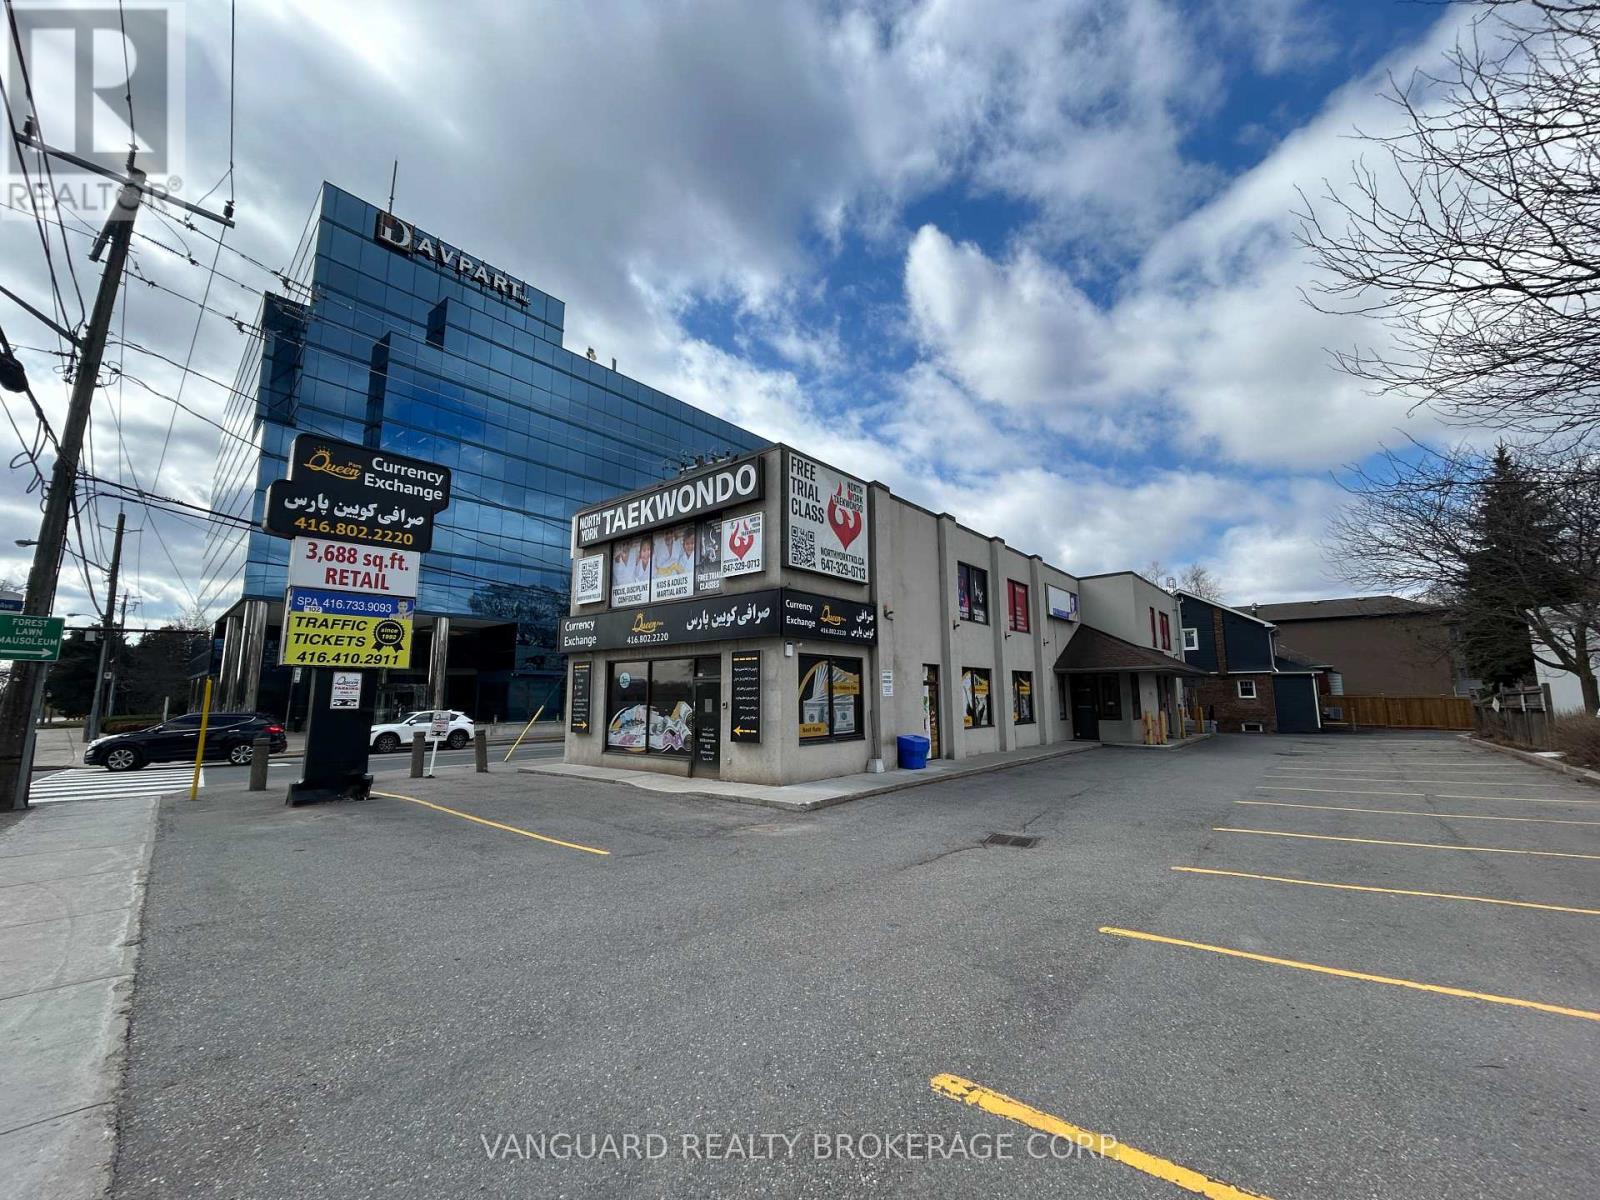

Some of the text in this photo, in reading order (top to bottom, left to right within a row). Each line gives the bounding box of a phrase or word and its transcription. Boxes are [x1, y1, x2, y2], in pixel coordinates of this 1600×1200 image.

[303, 452, 361, 480] Queen
[371, 457, 444, 486] Currency
[790, 456, 816, 482] FREE
[364, 472, 443, 501] Exchange
[790, 476, 821, 503] TRIAL
[283, 492, 329, 516] پارس
[602, 464, 757, 535] TAEKWONDO
[377, 505, 424, 529] صرافی
[579, 512, 600, 530] NORTH
[791, 498, 824, 524] CLASS
[294, 516, 413, 545] 416.802.2220
[581, 526, 599, 542] YORK
[305, 541, 409, 573] 3,688 sq.ft.
[324, 567, 389, 590] RETAIL
[820, 558, 866, 580] 647-329-0713
[297, 596, 392, 613] SPA 416.733.9093
[737, 603, 770, 626] صرافی
[785, 599, 813, 613] Currency
[12, 618, 49, 627] FOREST
[295, 616, 368, 632] TRAFFIC
[564, 619, 595, 632] Currency
[686, 609, 709, 631] پارس
[786, 615, 816, 629] Exchange
[16, 628, 43, 637] LAWN
[293, 632, 366, 647] TICKETS
[564, 635, 597, 647] Exchange
[627, 632, 669, 644] 416.802.2220
[296, 651, 399, 665] 416.410.2911
